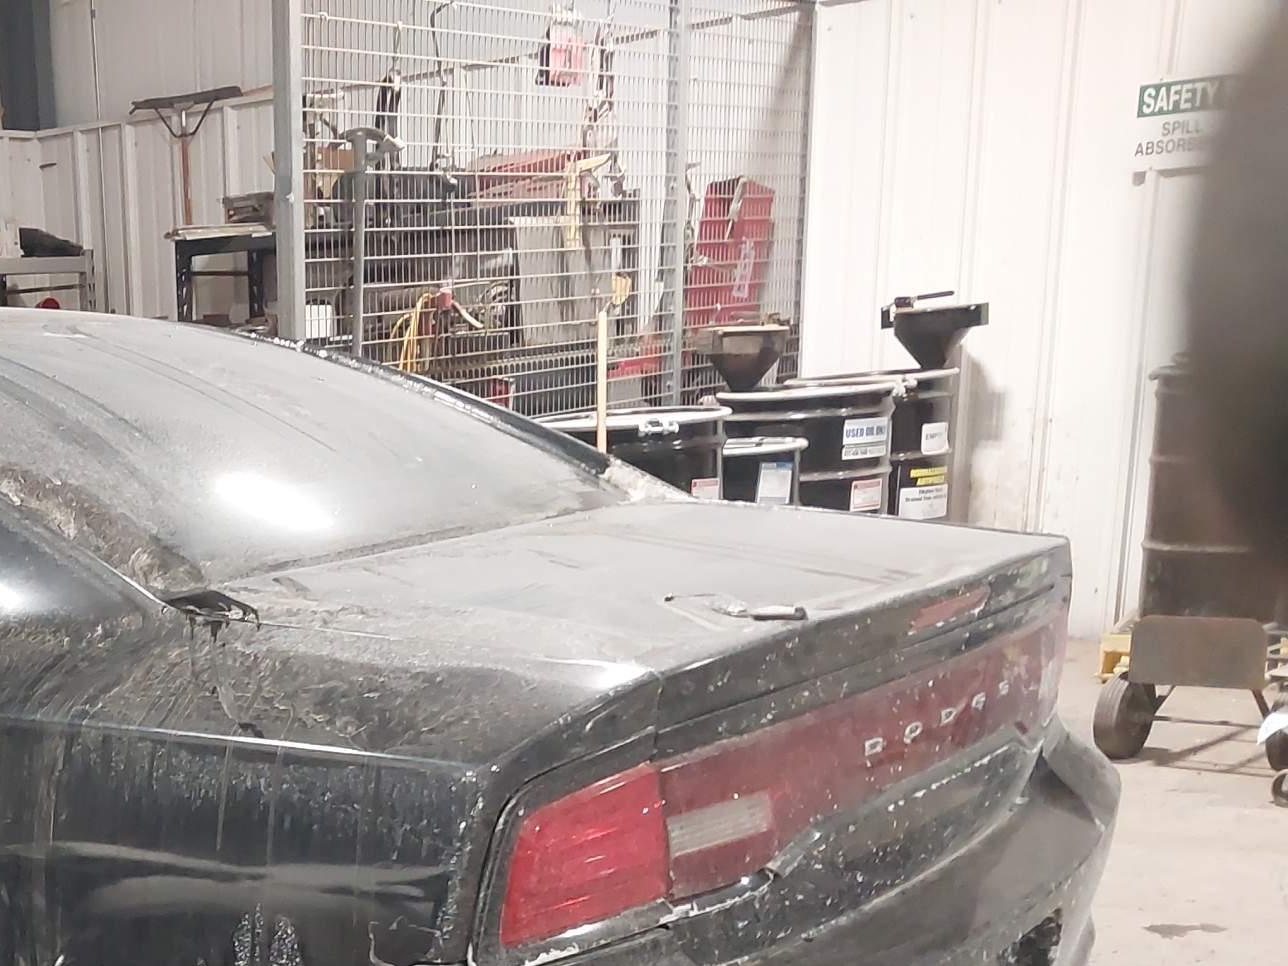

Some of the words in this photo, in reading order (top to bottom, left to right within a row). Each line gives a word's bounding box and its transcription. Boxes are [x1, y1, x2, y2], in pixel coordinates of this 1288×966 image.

[1142, 79, 1219, 114] SAFETY
[1162, 119, 1205, 137] SPILL
[845, 427, 865, 439] USED
